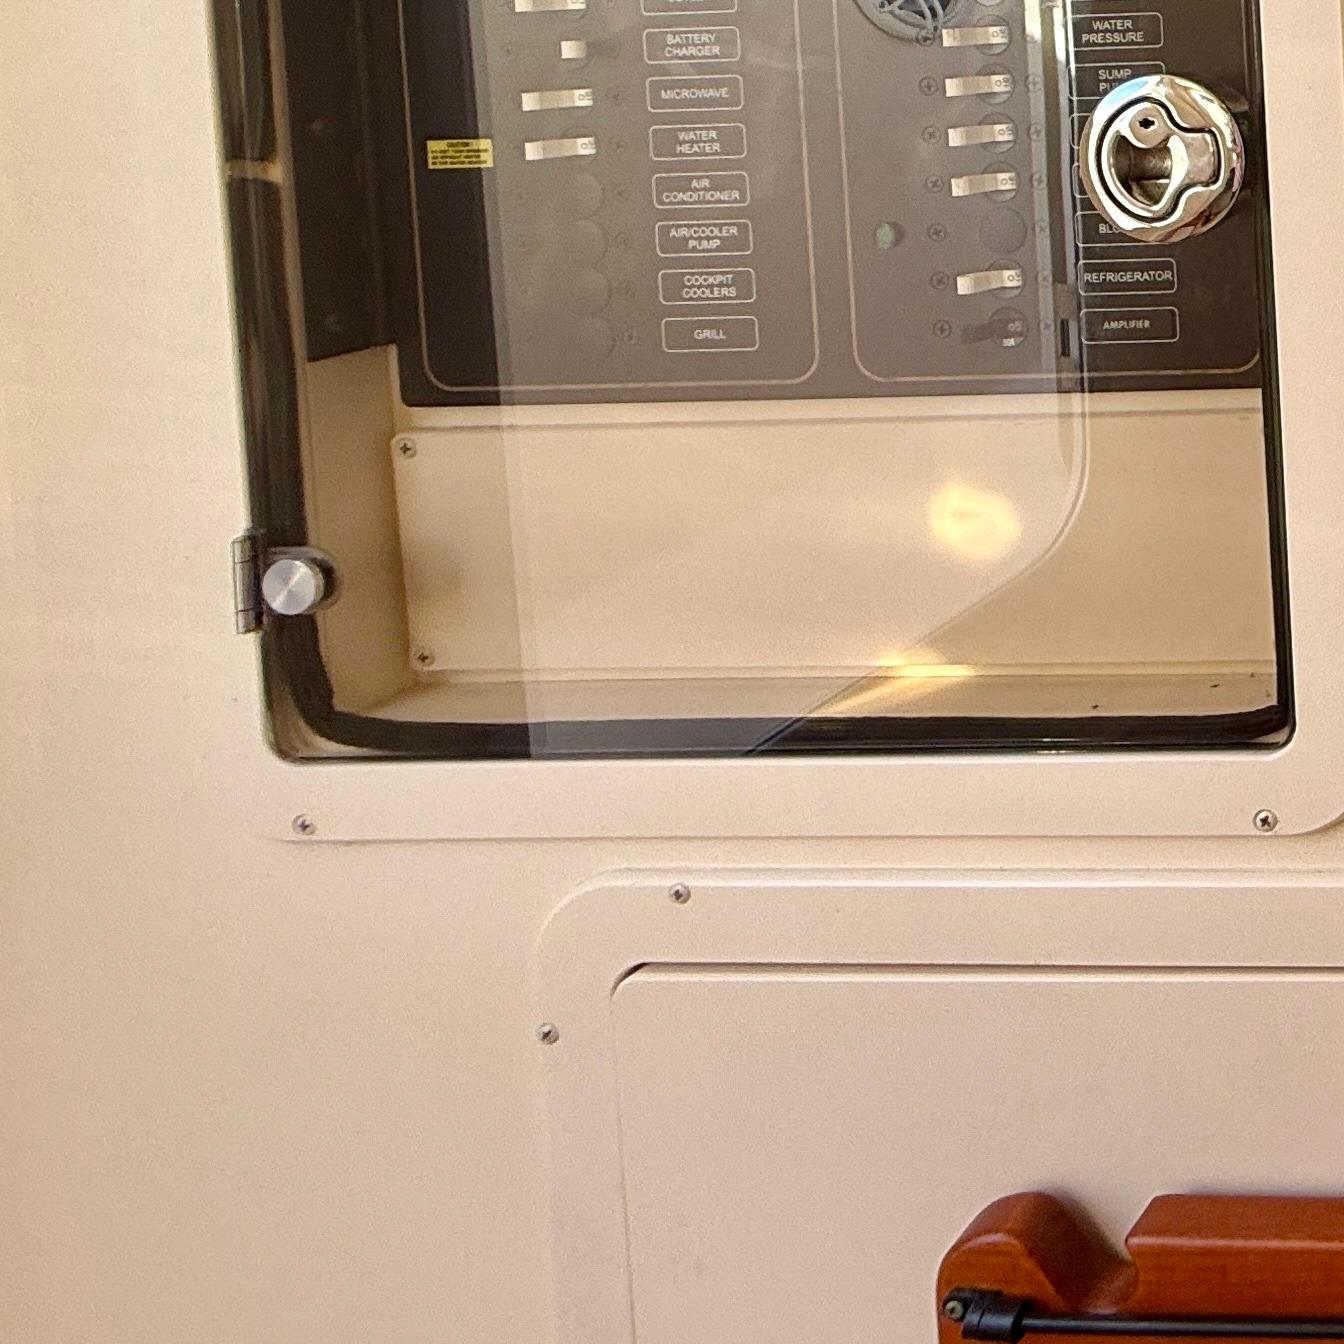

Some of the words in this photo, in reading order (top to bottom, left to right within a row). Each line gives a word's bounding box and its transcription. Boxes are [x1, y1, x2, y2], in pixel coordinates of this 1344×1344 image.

[1092, 19, 1133, 31] WATER
[666, 33, 716, 45] BATTERY
[1081, 31, 1144, 44] PRESSURE
[664, 45, 720, 57] CHARGER
[1098, 68, 1132, 80] SUMP
[661, 87, 729, 99] MICROWAVE
[677, 130, 718, 141] WATER
[676, 143, 720, 154] HEATER
[691, 178, 710, 189] AIR
[662, 190, 740, 202] CONDITIONER
[669, 226, 738, 238] AIR/COOLER
[688, 239, 721, 250] PUMP
[683, 275, 734, 286] COCKPIT
[1083, 270, 1173, 283] REFRIGERATOR
[682, 287, 736, 298] COOLERS
[1103, 319, 1151, 330] AMPLIFIER
[694, 328, 726, 340] GRILL
